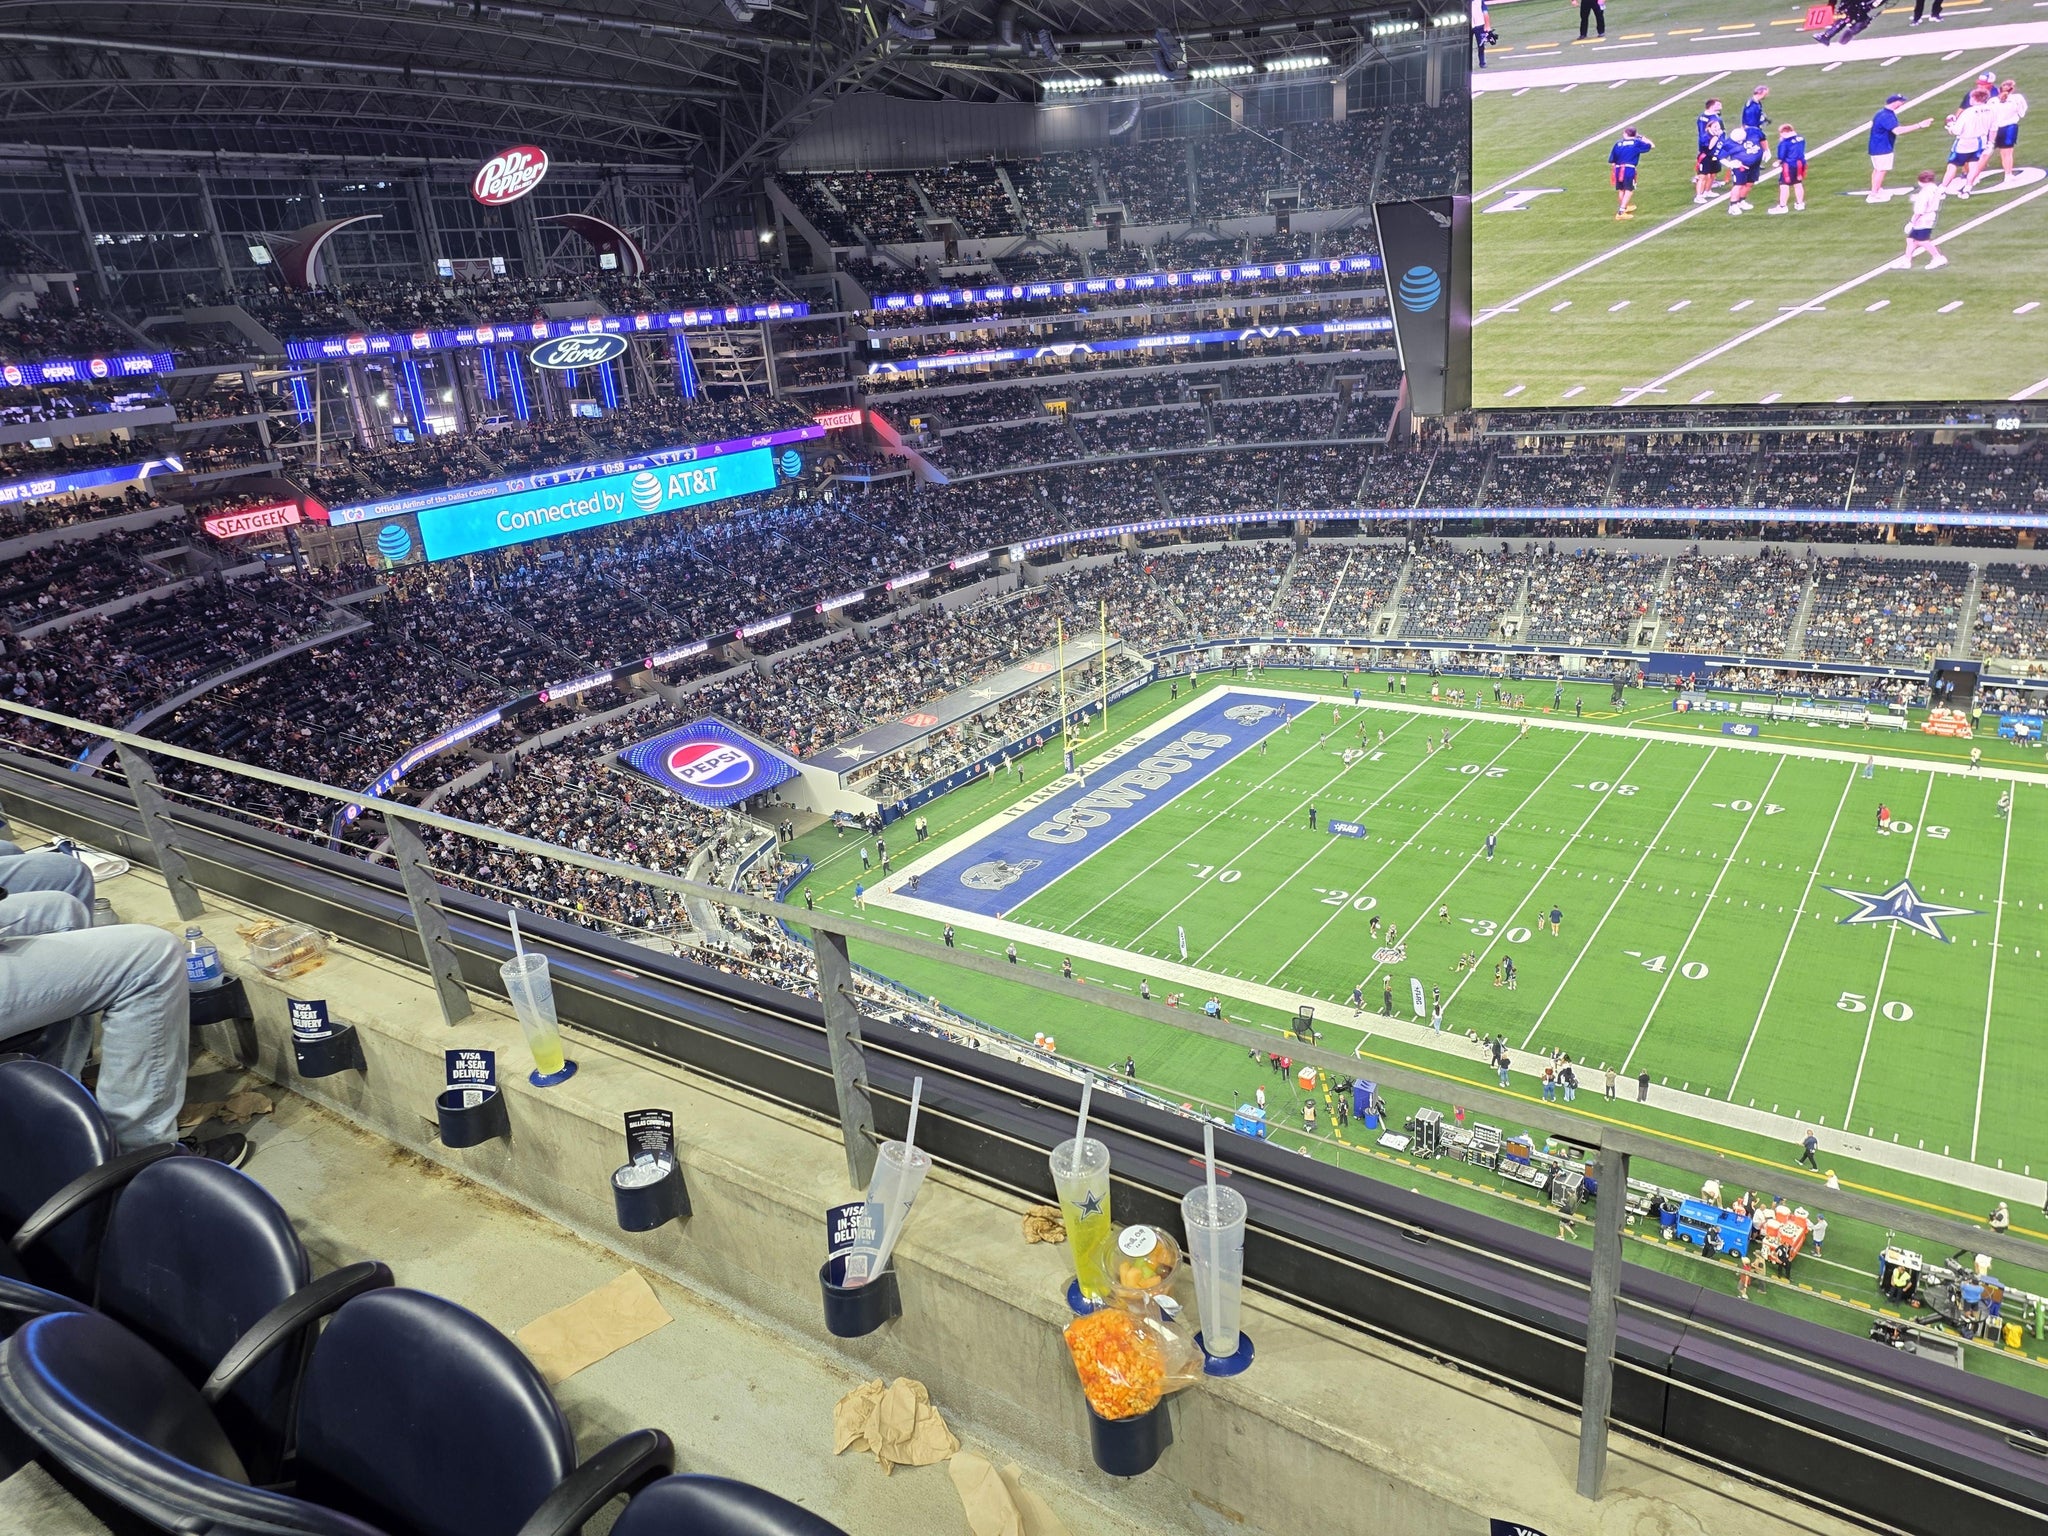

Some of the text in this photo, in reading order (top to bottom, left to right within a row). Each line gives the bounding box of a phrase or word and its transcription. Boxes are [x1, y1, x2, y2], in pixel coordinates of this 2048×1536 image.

[1809, 10, 1825, 25] 10
[503, 152, 532, 177] Dr
[475, 157, 544, 198] Pepper
[1028, 315, 1054, 323] RAYFIELD
[550, 337, 612, 363] Ford
[1137, 337, 1164, 347] JANUARY
[42, 366, 75, 378] PEPSI
[124, 359, 153, 371] PEPSI
[602, 462, 625, 474] 10:59
[20, 486, 31, 498] 3,
[31, 480, 56, 494] 2027
[375, 504, 401, 514] Official
[402, 500, 425, 510] Airline
[434, 495, 447, 503] the
[448, 491, 468, 501] Dallas
[469, 486, 498, 498] Cowboys
[496, 467, 718, 532] Connected by AT&T
[217, 509, 290, 537] SEATGEEK
[955, 552, 989, 570] Blockchain.com
[892, 572, 930, 590] Blockchain.com
[822, 592, 865, 612] Blockchain.com
[743, 616, 792, 638] Blockchain.com
[653, 643, 708, 667] Blockchain.com
[549, 673, 613, 701] Blockchain.com
[679, 750, 742, 779] PEPSI
[1459, 764, 1509, 778] 20
[1002, 806, 1025, 817] IT
[1023, 777, 1076, 804] TAKES
[1103, 749, 1125, 760] OF
[1123, 736, 1146, 747] US
[1028, 731, 1232, 845] COWBOYS
[1588, 781, 1640, 796] 30
[1730, 799, 1786, 816] 40
[1890, 820, 1951, 839] 50
[1191, 864, 1242, 883] 10
[1320, 889, 1377, 911] 20
[1470, 919, 1532, 944] 30
[1641, 954, 1710, 980] 40
[292, 1010, 317, 1019] IN-SEAT
[293, 1003, 311, 1011] VISA
[1836, 991, 1914, 1022] 50
[292, 1018, 322, 1028] DELIVERY
[452, 1069, 490, 1079] DELIVERY
[455, 1060, 486, 1070] IN-SEAT
[840, 1206, 866, 1217] VISA
[837, 1216, 872, 1231] IN-SEAT
[834, 1228, 876, 1244] DELIVERY
